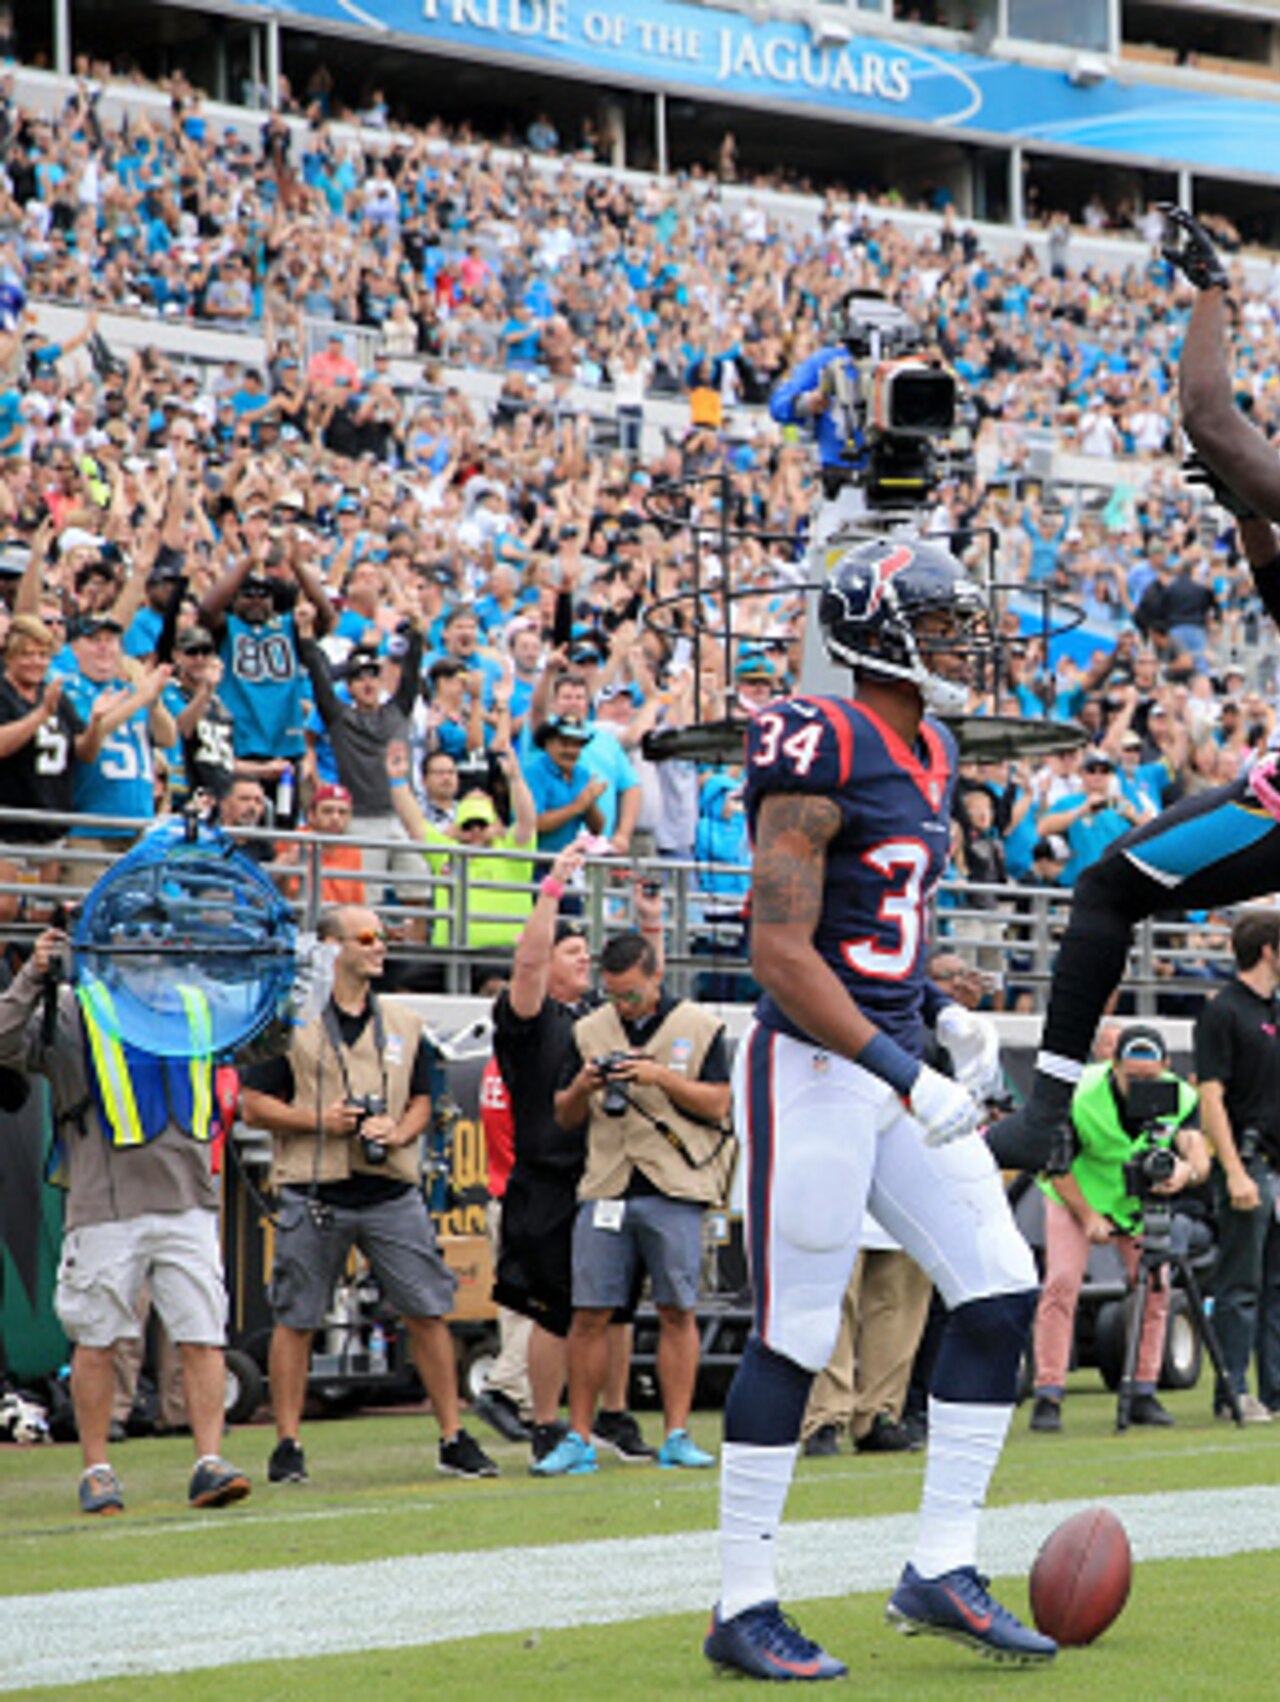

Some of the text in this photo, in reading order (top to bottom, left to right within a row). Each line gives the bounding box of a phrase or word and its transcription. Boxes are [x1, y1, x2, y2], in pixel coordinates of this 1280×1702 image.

[582, 12, 629, 46] OF
[636, 20, 702, 61] THE
[716, 27, 911, 102] JAGUARS
[232, 633, 294, 682] 80
[99, 719, 154, 780] 51
[752, 711, 823, 777] 34
[838, 834, 950, 982] 3
